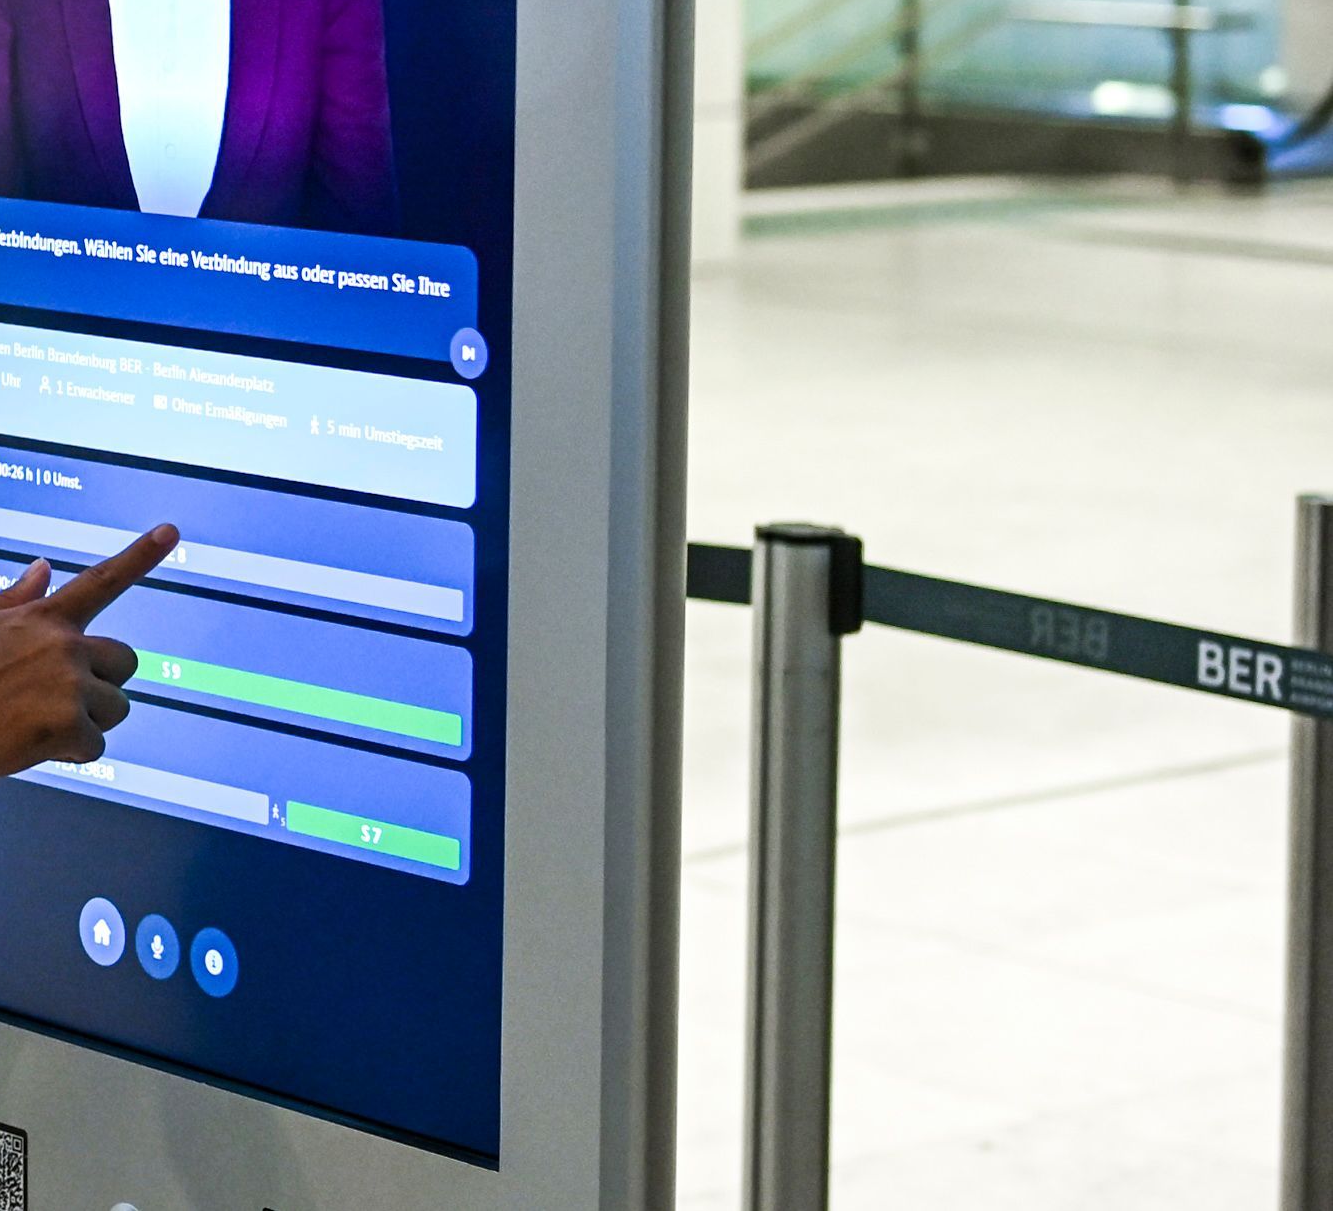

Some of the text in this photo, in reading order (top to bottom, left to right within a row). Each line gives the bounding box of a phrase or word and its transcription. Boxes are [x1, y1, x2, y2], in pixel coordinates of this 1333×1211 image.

[84, 238, 133, 261] Wählen
[135, 244, 156, 264] Sie
[159, 247, 188, 268] eine
[191, 250, 270, 281] Verbindung
[273, 263, 299, 280] aus
[301, 265, 335, 284] oder
[338, 270, 388, 291] passen
[391, 273, 415, 293] Sie
[417, 276, 451, 298] Ihre
[1, 373, 22, 389] Uhr
[13, 342, 45, 360] Berlin
[47, 348, 117, 374] Brandenburg
[119, 358, 143, 375] BER
[153, 362, 186, 381] Berlin
[189, 367, 275, 394] Alexanderplatz
[56, 381, 136, 406] 1 Erwachsener
[172, 398, 202, 416] Ohne
[327, 420, 443, 451] 5 min Umstiegszeit
[25, 466, 34, 482] h
[43, 470, 52, 485] 0
[53, 471, 83, 490] Umst.
[1197, 639, 1283, 700] BER
